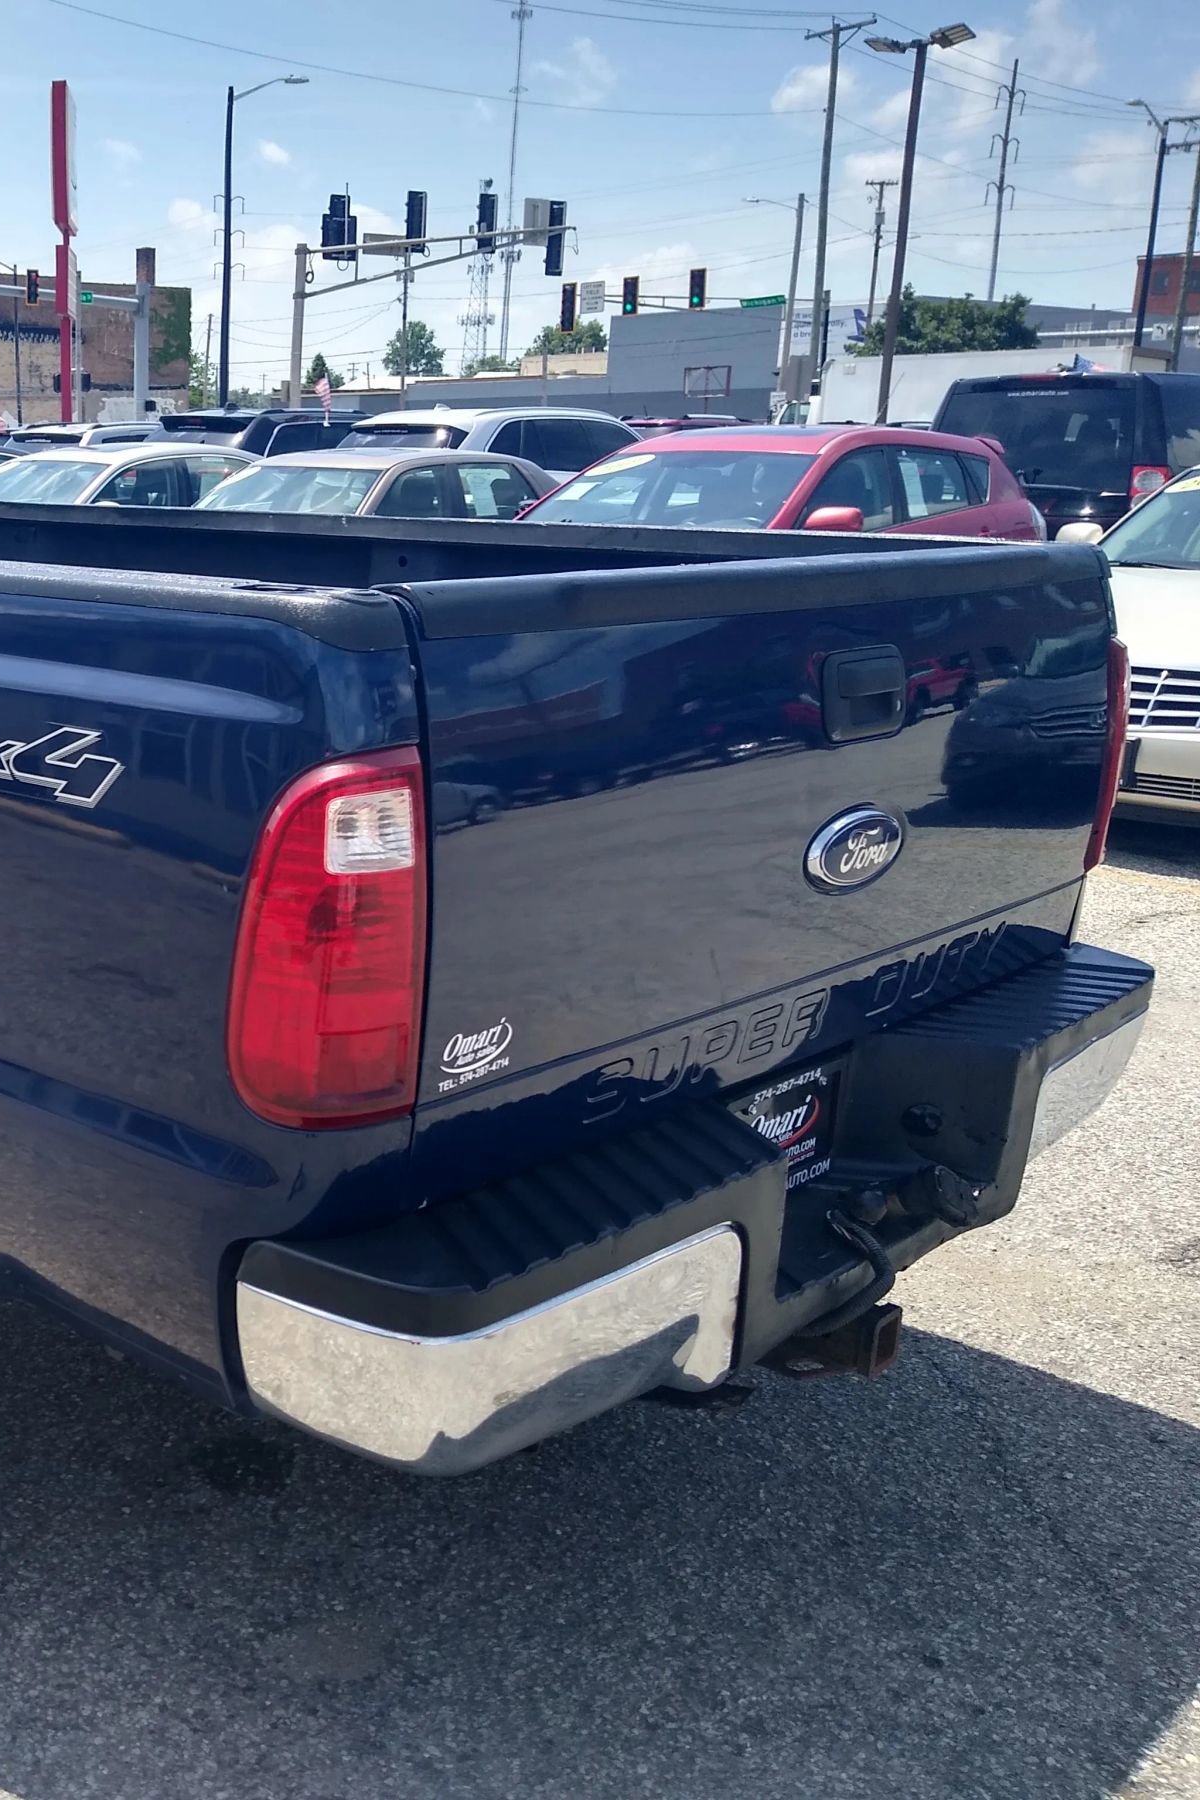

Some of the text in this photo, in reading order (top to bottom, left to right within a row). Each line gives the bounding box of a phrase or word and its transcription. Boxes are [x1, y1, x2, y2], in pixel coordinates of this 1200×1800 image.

[840, 826, 890, 873] Ford
[443, 1016, 507, 1062] Omari
[582, 920, 1008, 1124] SUPER DUTY
[438, 1056, 510, 1092] TEL: 574-287-4714
[753, 1067, 822, 1104] 574-287-4714
